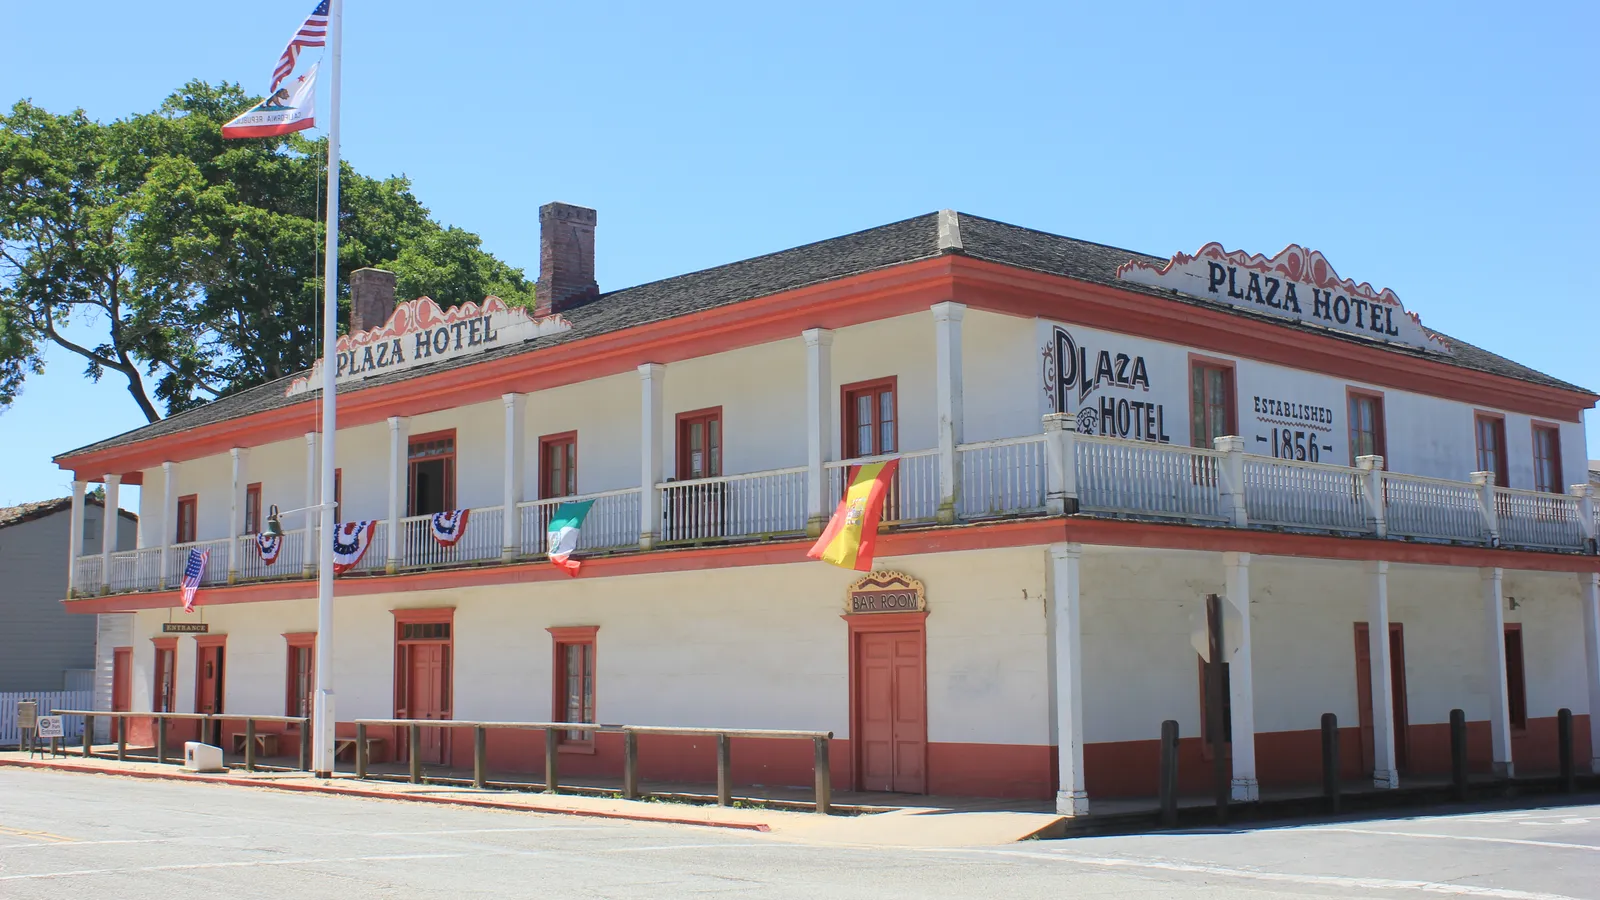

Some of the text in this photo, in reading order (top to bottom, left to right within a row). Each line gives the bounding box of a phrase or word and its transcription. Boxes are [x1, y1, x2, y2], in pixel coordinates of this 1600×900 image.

[1208, 259, 1399, 337] PLAZA HOTEL
[335, 315, 498, 378] PLAZA HOTEL
[1099, 396, 1170, 444] HOTEL
[1254, 395, 1333, 424] ESTABLISHED
[853, 592, 918, 610] BAR ROOM
[166, 624, 206, 632] ENTRANCE
